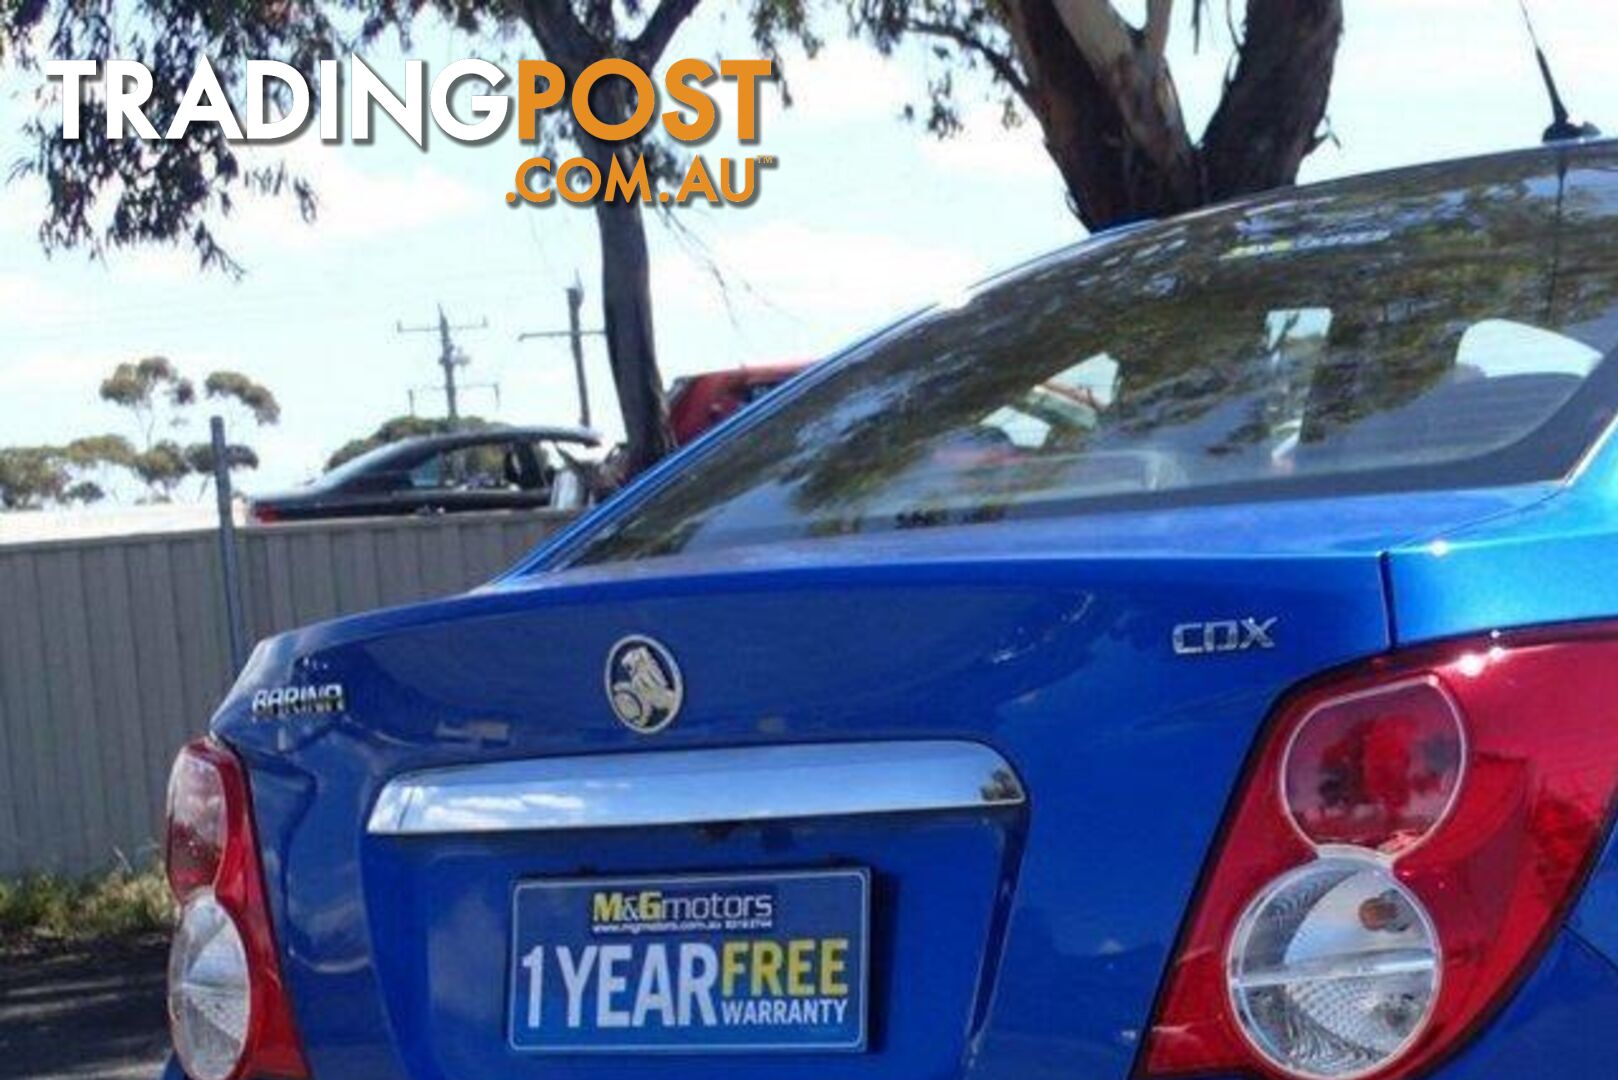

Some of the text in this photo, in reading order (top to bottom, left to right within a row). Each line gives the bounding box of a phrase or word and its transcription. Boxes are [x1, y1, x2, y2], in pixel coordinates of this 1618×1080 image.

[1172, 616, 1278, 654] CDX
[522, 938, 848, 1029] 1 YEAR FREE
[721, 999, 848, 1026] WARRANTY
